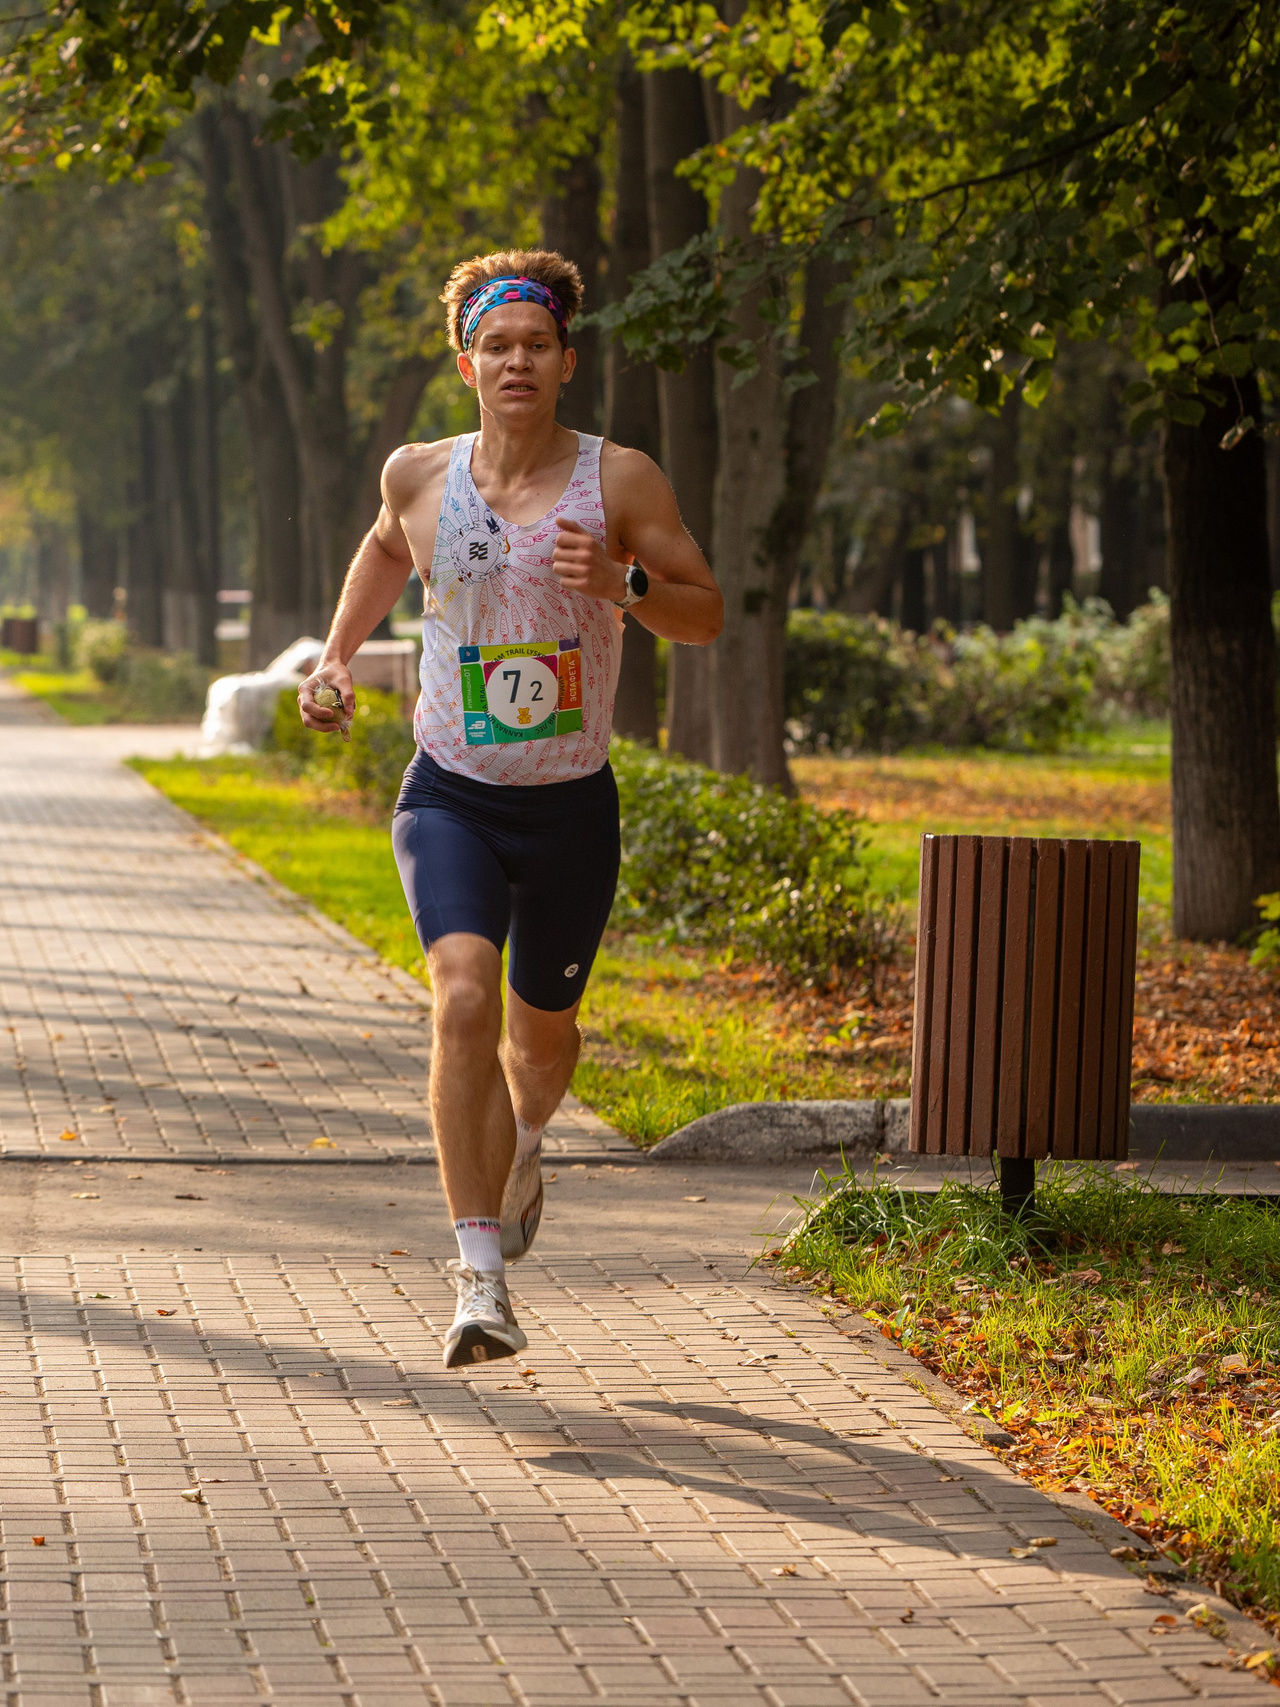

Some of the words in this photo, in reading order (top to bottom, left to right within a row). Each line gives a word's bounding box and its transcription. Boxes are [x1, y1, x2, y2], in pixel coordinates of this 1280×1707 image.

[485, 653, 506, 674] DREAM
[505, 648, 525, 657] TRAIL
[526, 648, 555, 667] LYSKOVO
[502, 669, 521, 704] 7
[530, 680, 544, 702] 2
[568, 659, 578, 703] ЭСТАФЕТА
[494, 722, 524, 738] KANNAS
[535, 724, 549, 735] ЛЕС
